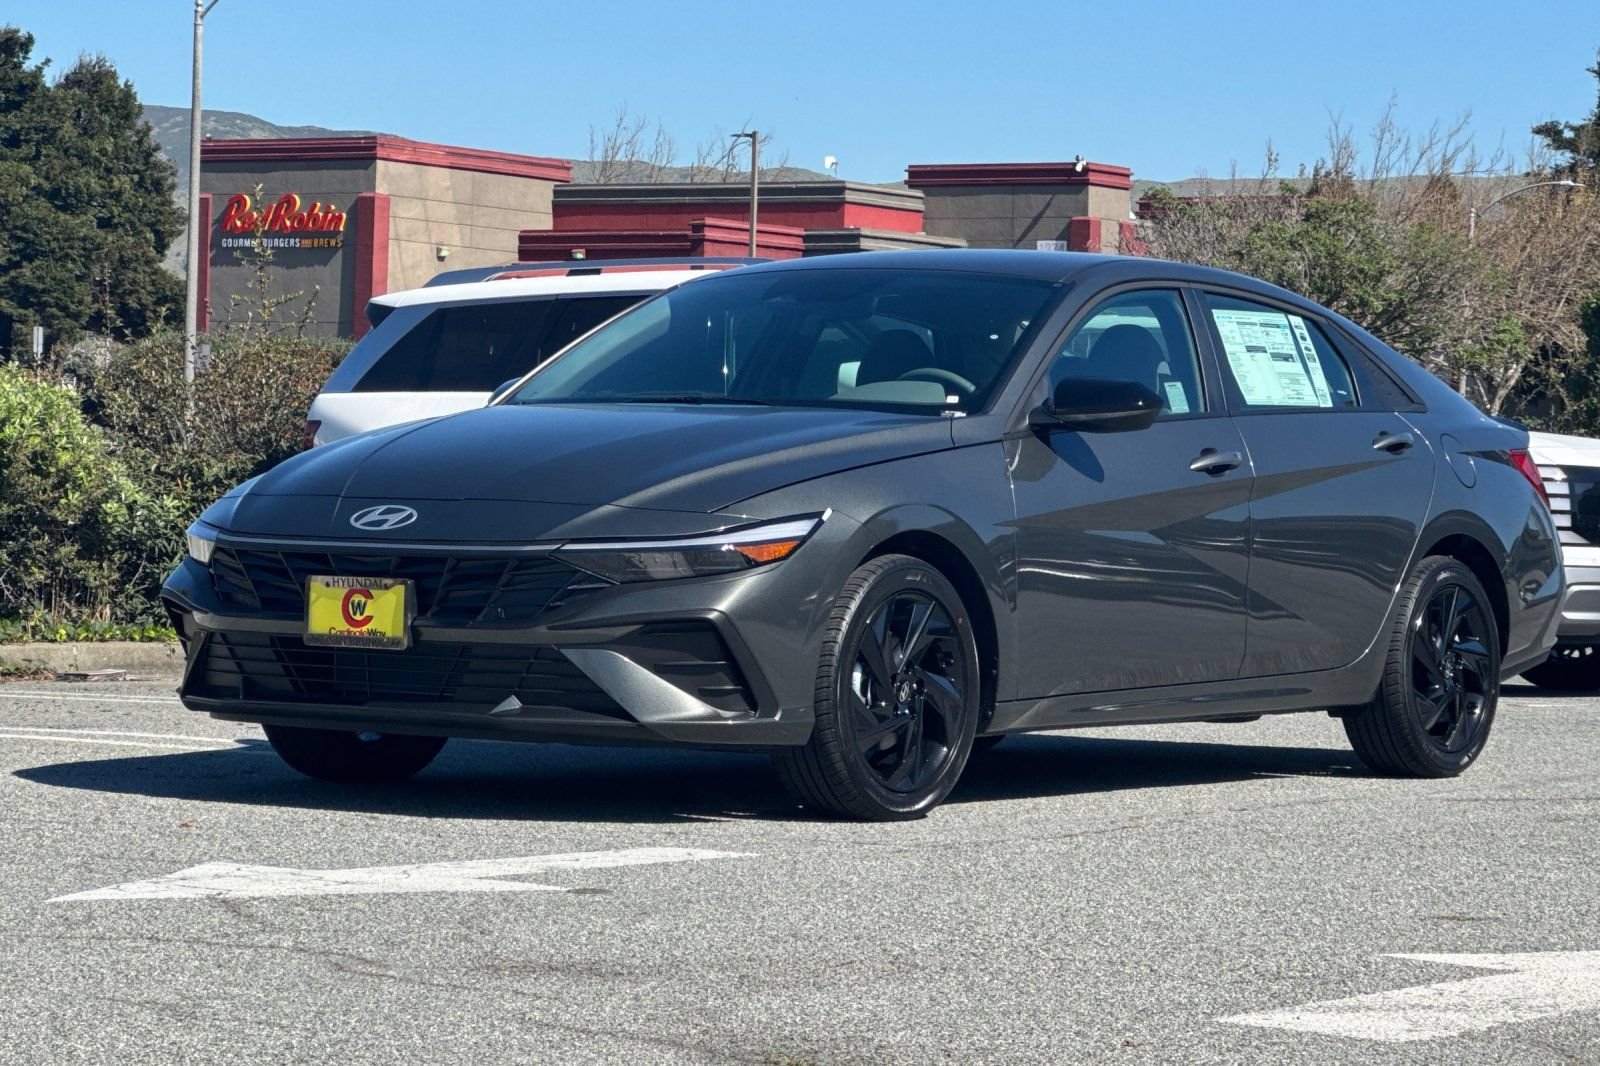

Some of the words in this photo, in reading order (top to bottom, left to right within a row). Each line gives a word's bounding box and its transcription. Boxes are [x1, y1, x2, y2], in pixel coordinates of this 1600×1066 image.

[221, 194, 276, 233] Red
[272, 194, 346, 233] Robin
[221, 238, 261, 248] GOURME
[262, 238, 300, 248] BURGERS
[313, 237, 342, 247] BREWS
[332, 577, 383, 588] HYUNDAI
